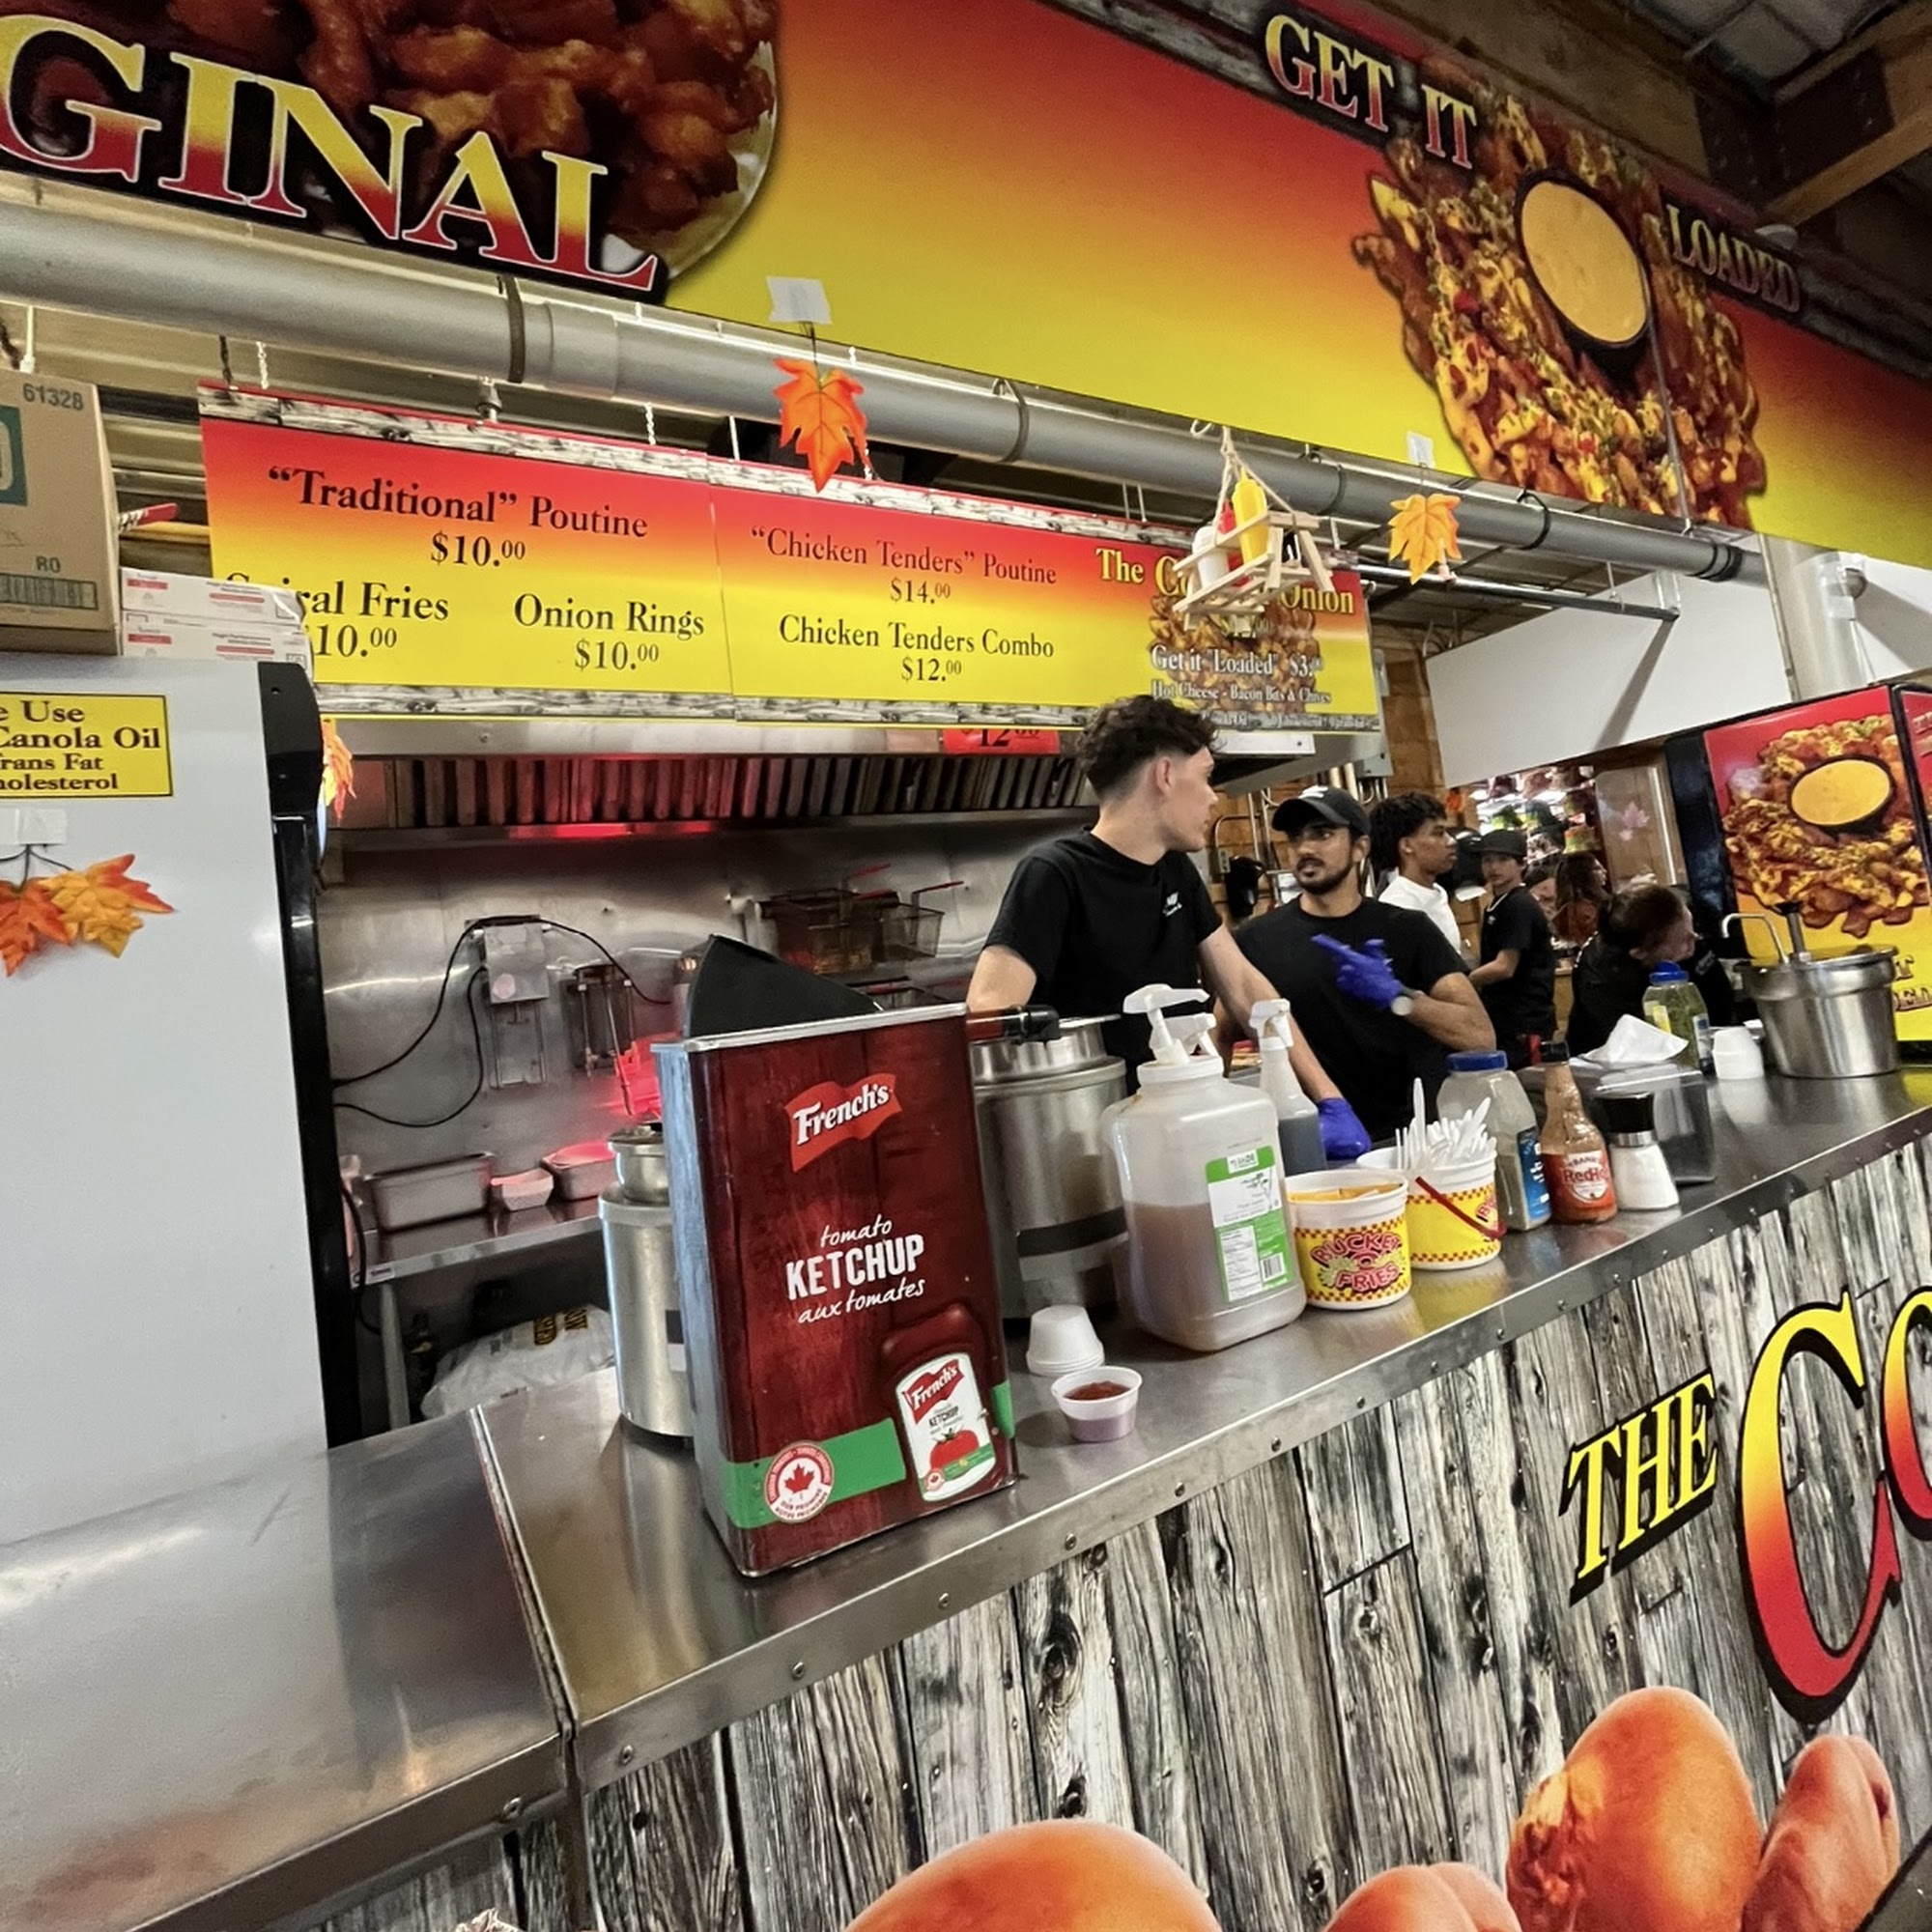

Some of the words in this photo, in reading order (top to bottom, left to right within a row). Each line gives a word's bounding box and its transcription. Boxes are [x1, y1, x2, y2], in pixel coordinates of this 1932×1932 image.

[1263, 13, 1394, 133] GET
[1420, 82, 1477, 170] IT
[0, 14, 660, 292] GINAL
[1664, 203, 1804, 314] LOADED
[23, 383, 85, 412] 61328
[269, 466, 517, 524] “Traditional”
[530, 495, 648, 538] Poutine
[431, 531, 526, 567] $10.00
[752, 526, 867, 564] “Chicken
[876, 539, 976, 575] Tenders”
[983, 553, 1057, 584] Poutine
[1095, 548, 1146, 584] The
[359, 582, 449, 621] Fries
[890, 577, 952, 605] $14.00
[514, 593, 614, 630] Onion
[626, 600, 705, 640] Rings
[303, 624, 398, 659] 10.00
[779, 613, 880, 647] Chicken
[888, 621, 975, 653] Tenders
[982, 629, 1055, 658] Combo
[574, 639, 660, 672] $10.00
[901, 656, 962, 682] $12.00
[1151, 644, 1186, 671] Get
[1188, 647, 1202, 672] it
[1151, 678, 1176, 700] Hot
[1178, 681, 1219, 699] Cheese
[1230, 685, 1263, 701] Bacon
[20, 699, 85, 723] Use
[113, 726, 160, 749] Oil
[64, 753, 104, 771] Fat
[792, 1082, 891, 1147] French's
[819, 1213, 893, 1248] tomato
[785, 1234, 925, 1301] KETCHUP
[1335, 1262, 1400, 1293] FRIES
[797, 1300, 843, 1324] aux
[845, 1276, 926, 1314] tomates
[910, 1364, 959, 1411] French's
[1561, 1370, 1718, 1599] THE
